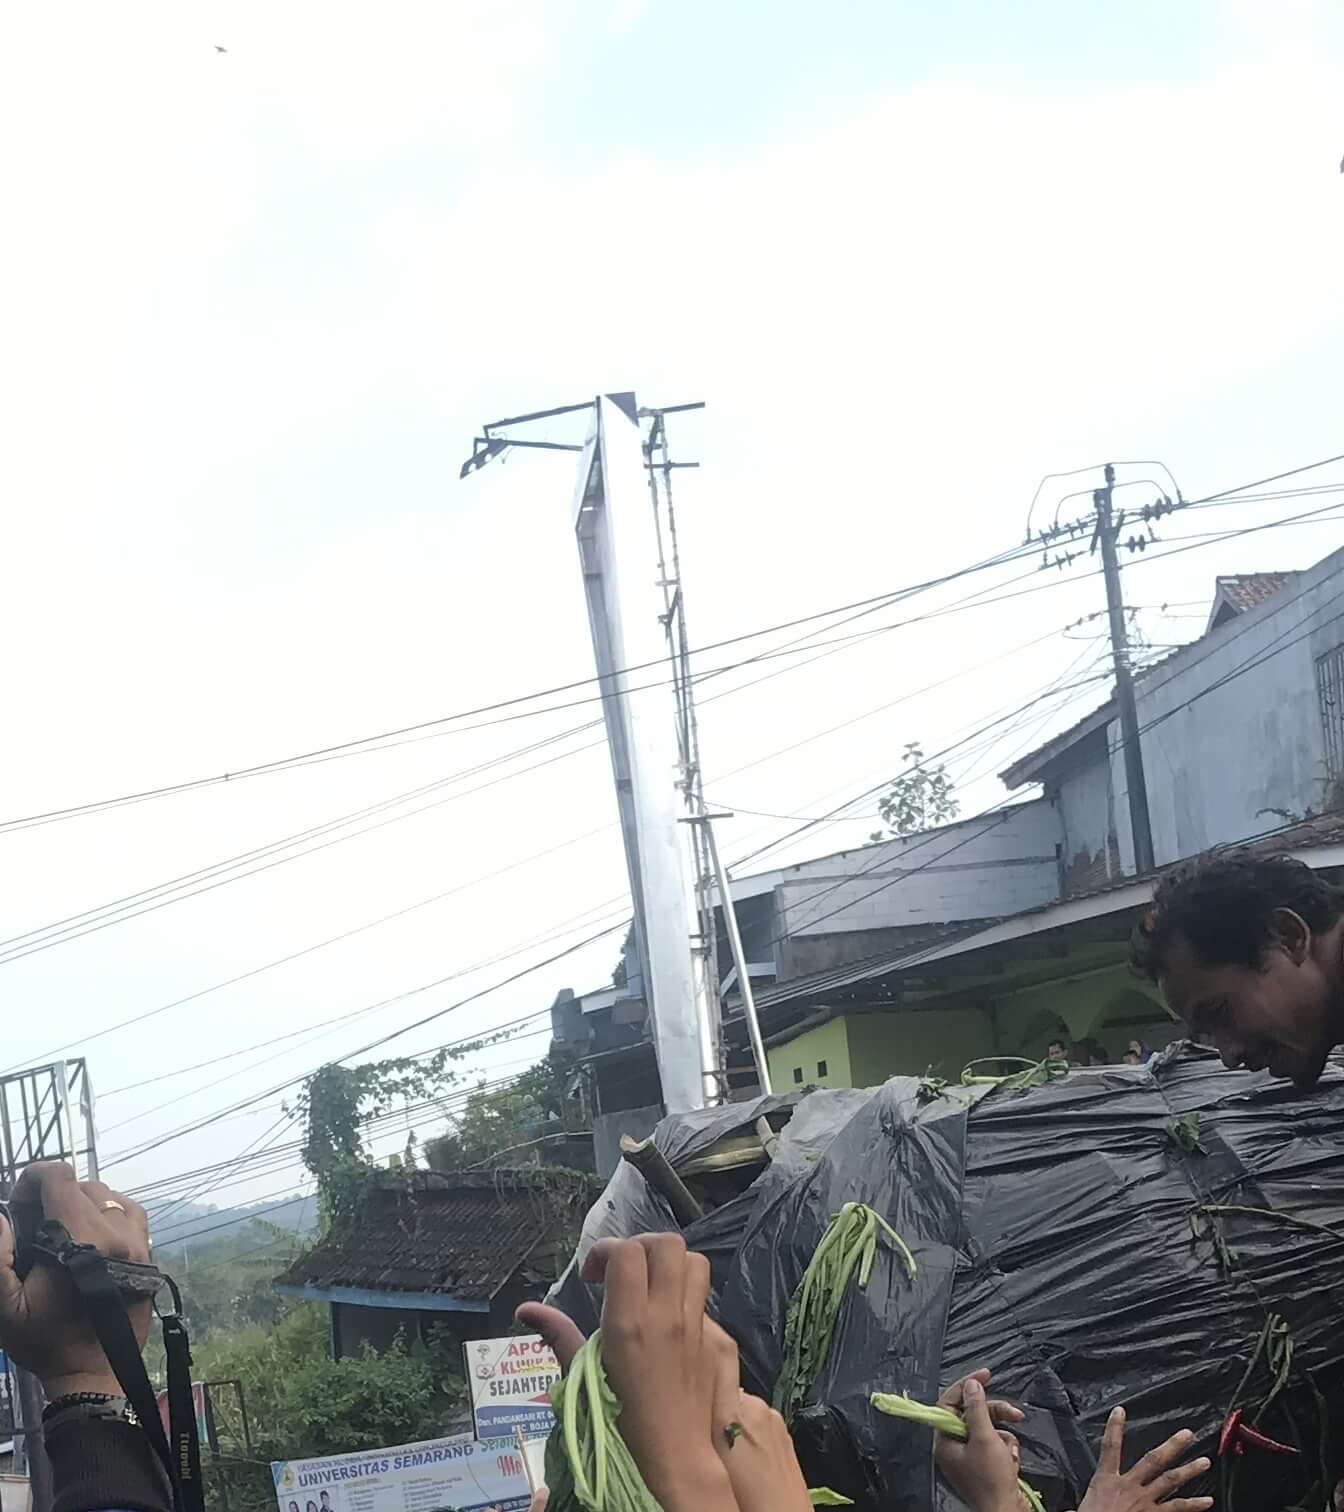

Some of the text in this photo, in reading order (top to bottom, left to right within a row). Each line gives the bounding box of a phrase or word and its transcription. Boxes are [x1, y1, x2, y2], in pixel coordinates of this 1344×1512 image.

[507, 1341, 545, 1357] APO
[298, 1458, 389, 1488] UNIVERSITAS
[393, 1444, 474, 1470] SEMARANG
